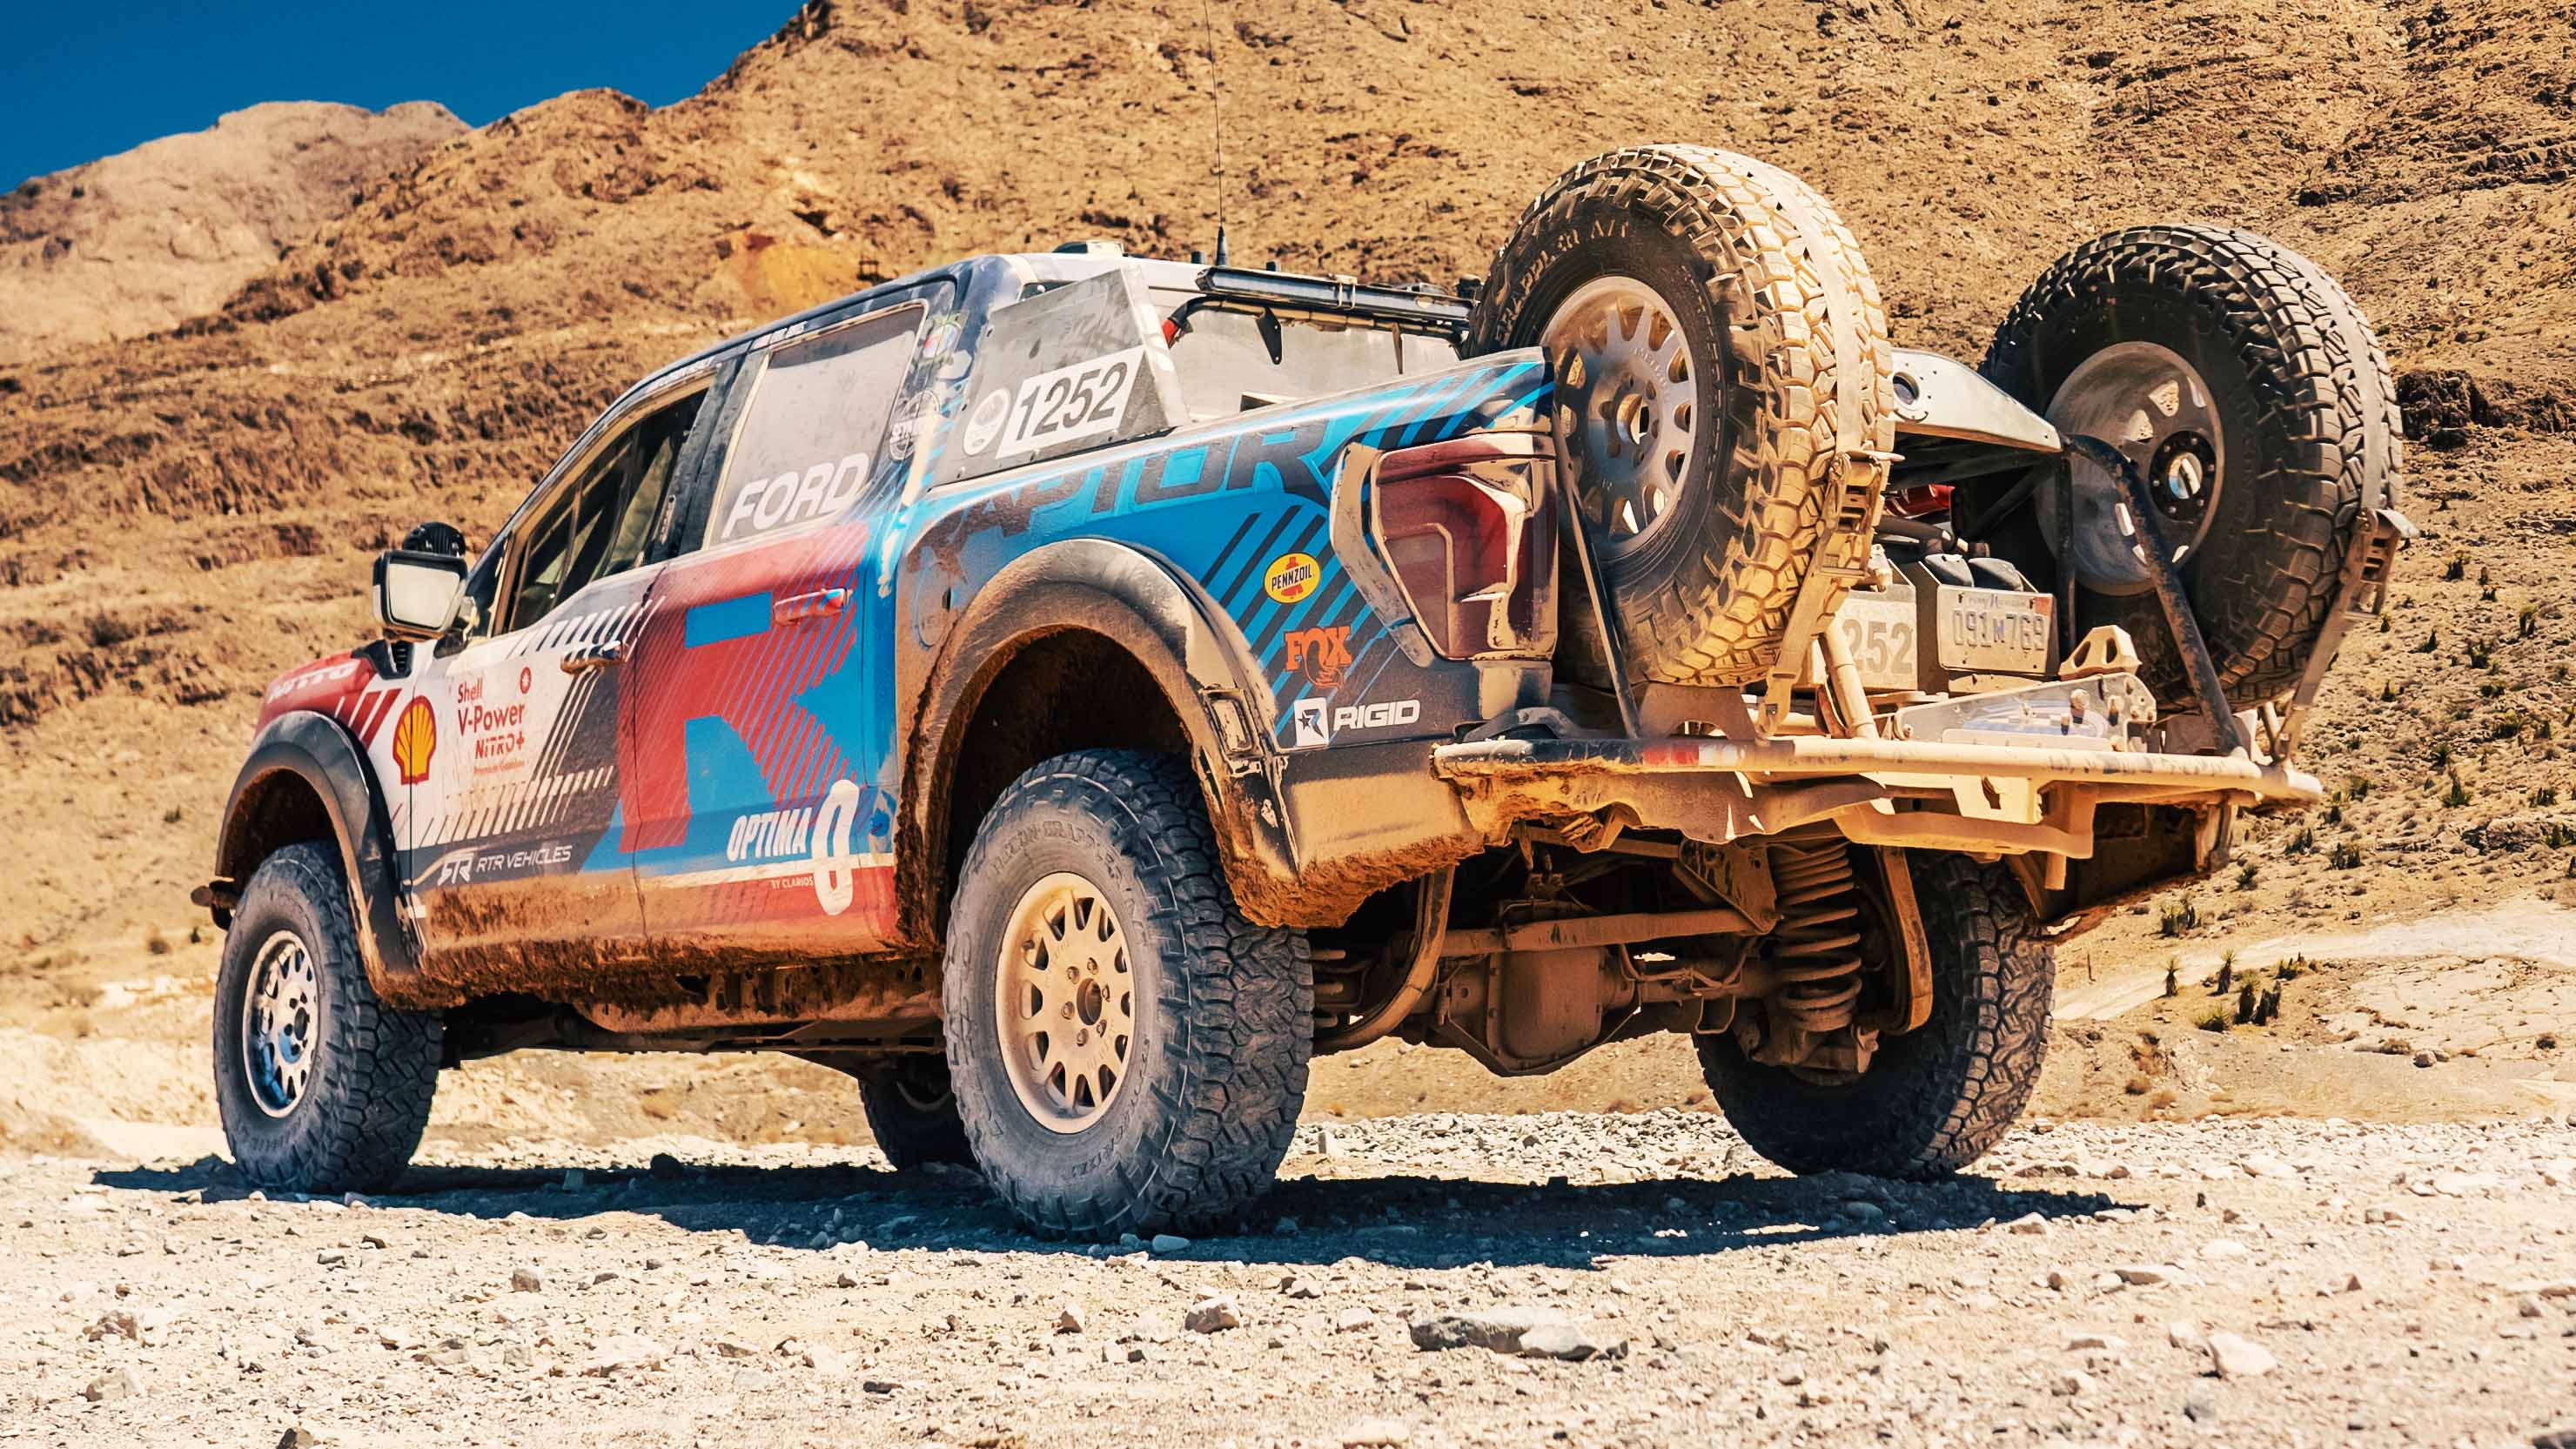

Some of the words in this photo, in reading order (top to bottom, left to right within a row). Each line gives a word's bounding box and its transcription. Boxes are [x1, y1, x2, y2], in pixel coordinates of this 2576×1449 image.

[1016, 362, 1128, 440] 1252
[721, 452, 869, 540] FORD
[1271, 564, 1312, 592] PENNZOIL
[1284, 625, 1352, 689] FOX
[458, 677, 483, 704] Shell
[458, 703, 526, 737] V-Power
[1333, 699, 1420, 732] RIGID
[727, 807, 813, 862] OPTIMA
[476, 854, 505, 874] RTR
[506, 845, 574, 869] VEHICLES
